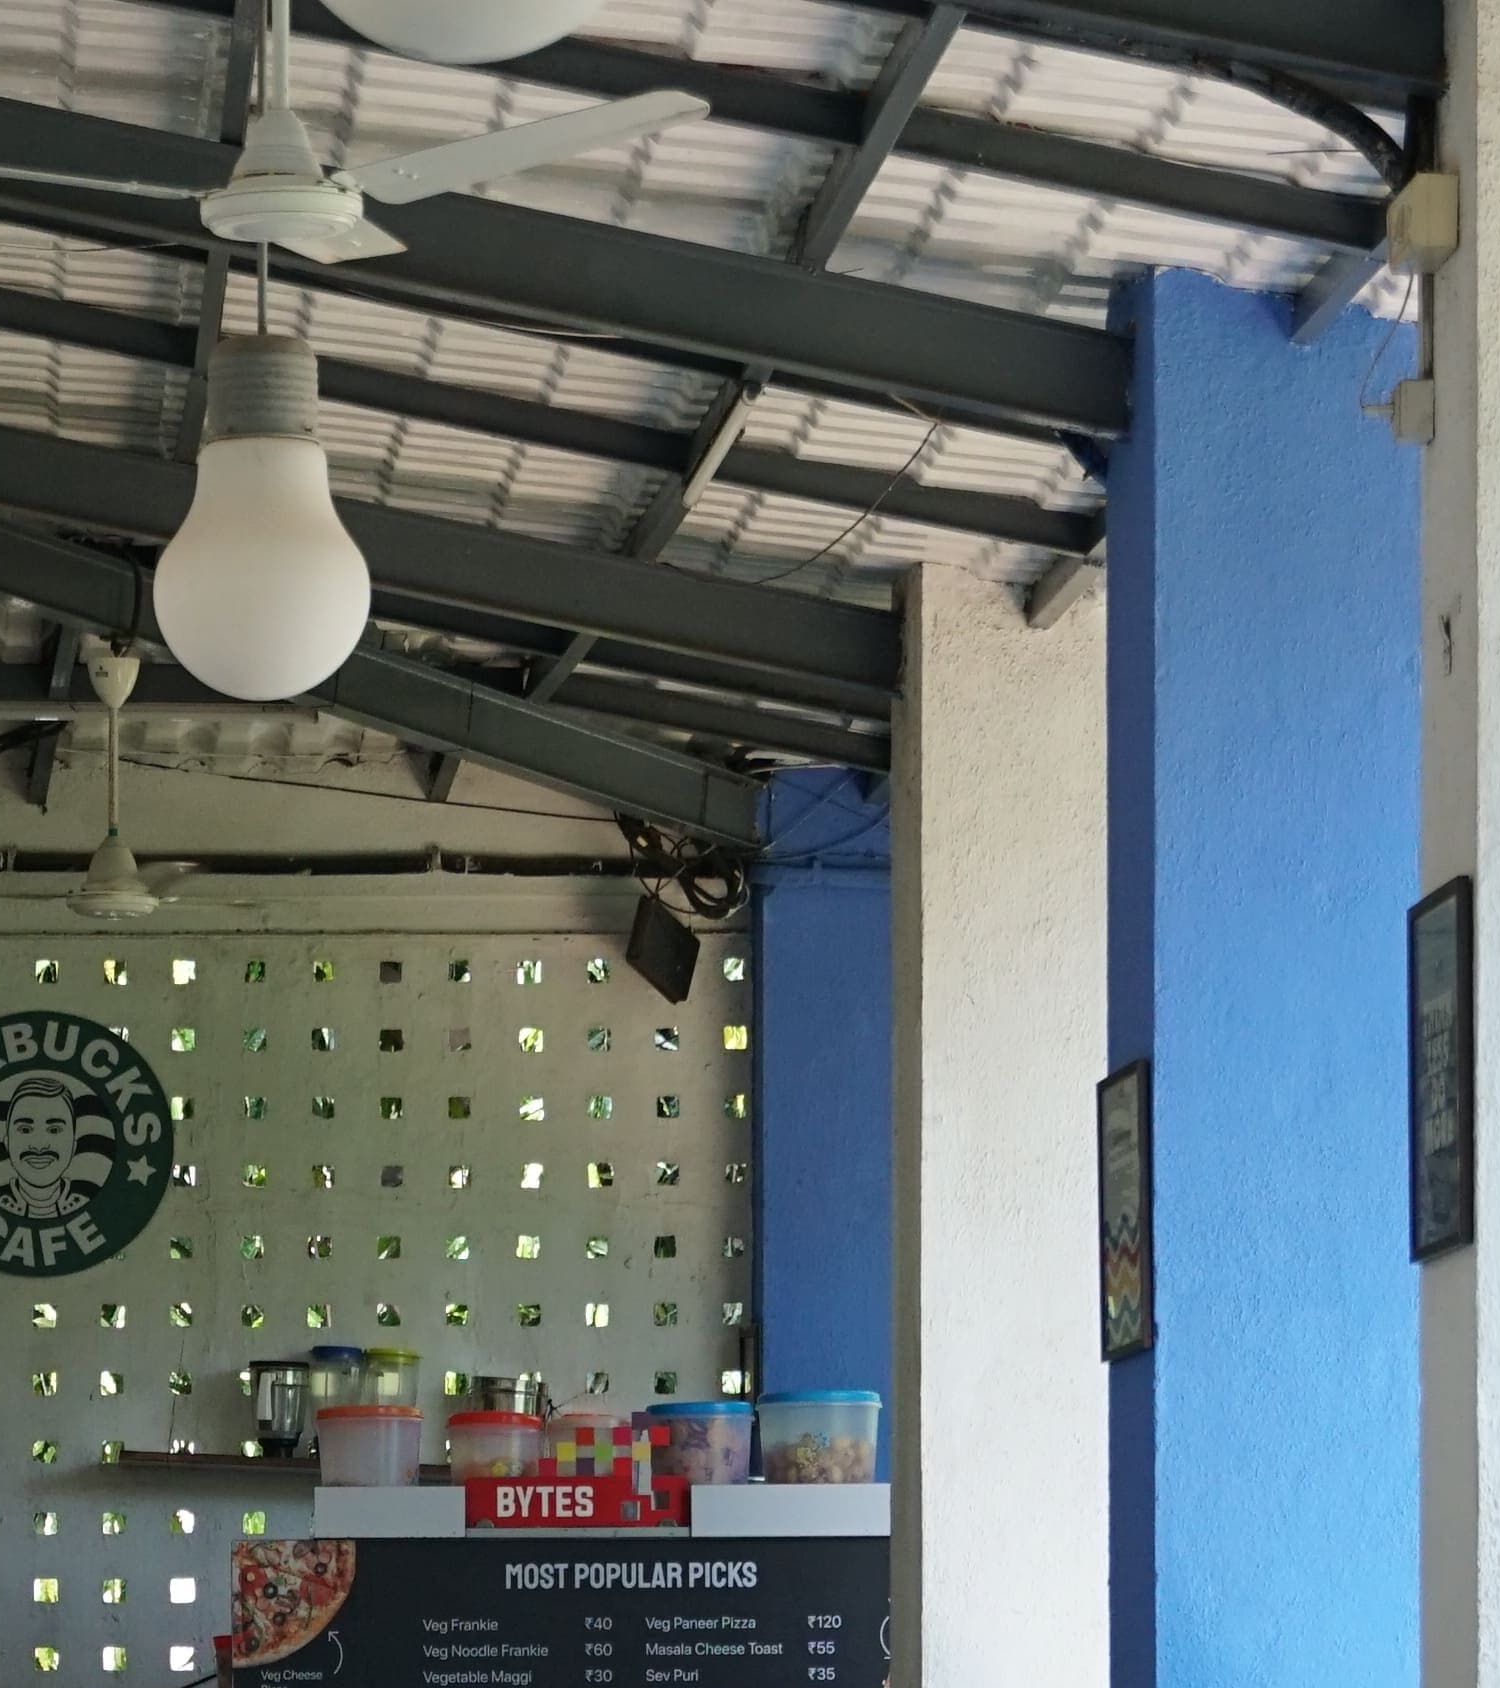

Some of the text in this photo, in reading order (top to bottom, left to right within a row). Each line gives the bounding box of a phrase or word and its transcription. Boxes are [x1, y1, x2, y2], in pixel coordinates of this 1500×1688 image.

[496, 1485, 594, 1518] BYTES
[505, 1561, 758, 1590] MOST POPULAR PICKS
[422, 1618, 499, 1635] Veg Frankie
[584, 1616, 613, 1631] ₹40
[644, 1616, 757, 1633] Veg Paneer Pizza
[807, 1614, 842, 1629] ₹120
[422, 1643, 549, 1661] Veg Noodle Frankie
[584, 1642, 613, 1657] ₹60
[645, 1641, 783, 1656] Masala Cheese Toast
[807, 1640, 836, 1655] ₹55
[260, 1669, 323, 1683] Veg Cheese
[422, 1669, 532, 1687] Vegetable Maggi
[585, 1668, 613, 1683] ₹30
[645, 1668, 699, 1682] Sev Puri
[807, 1666, 836, 1681] ₹35
